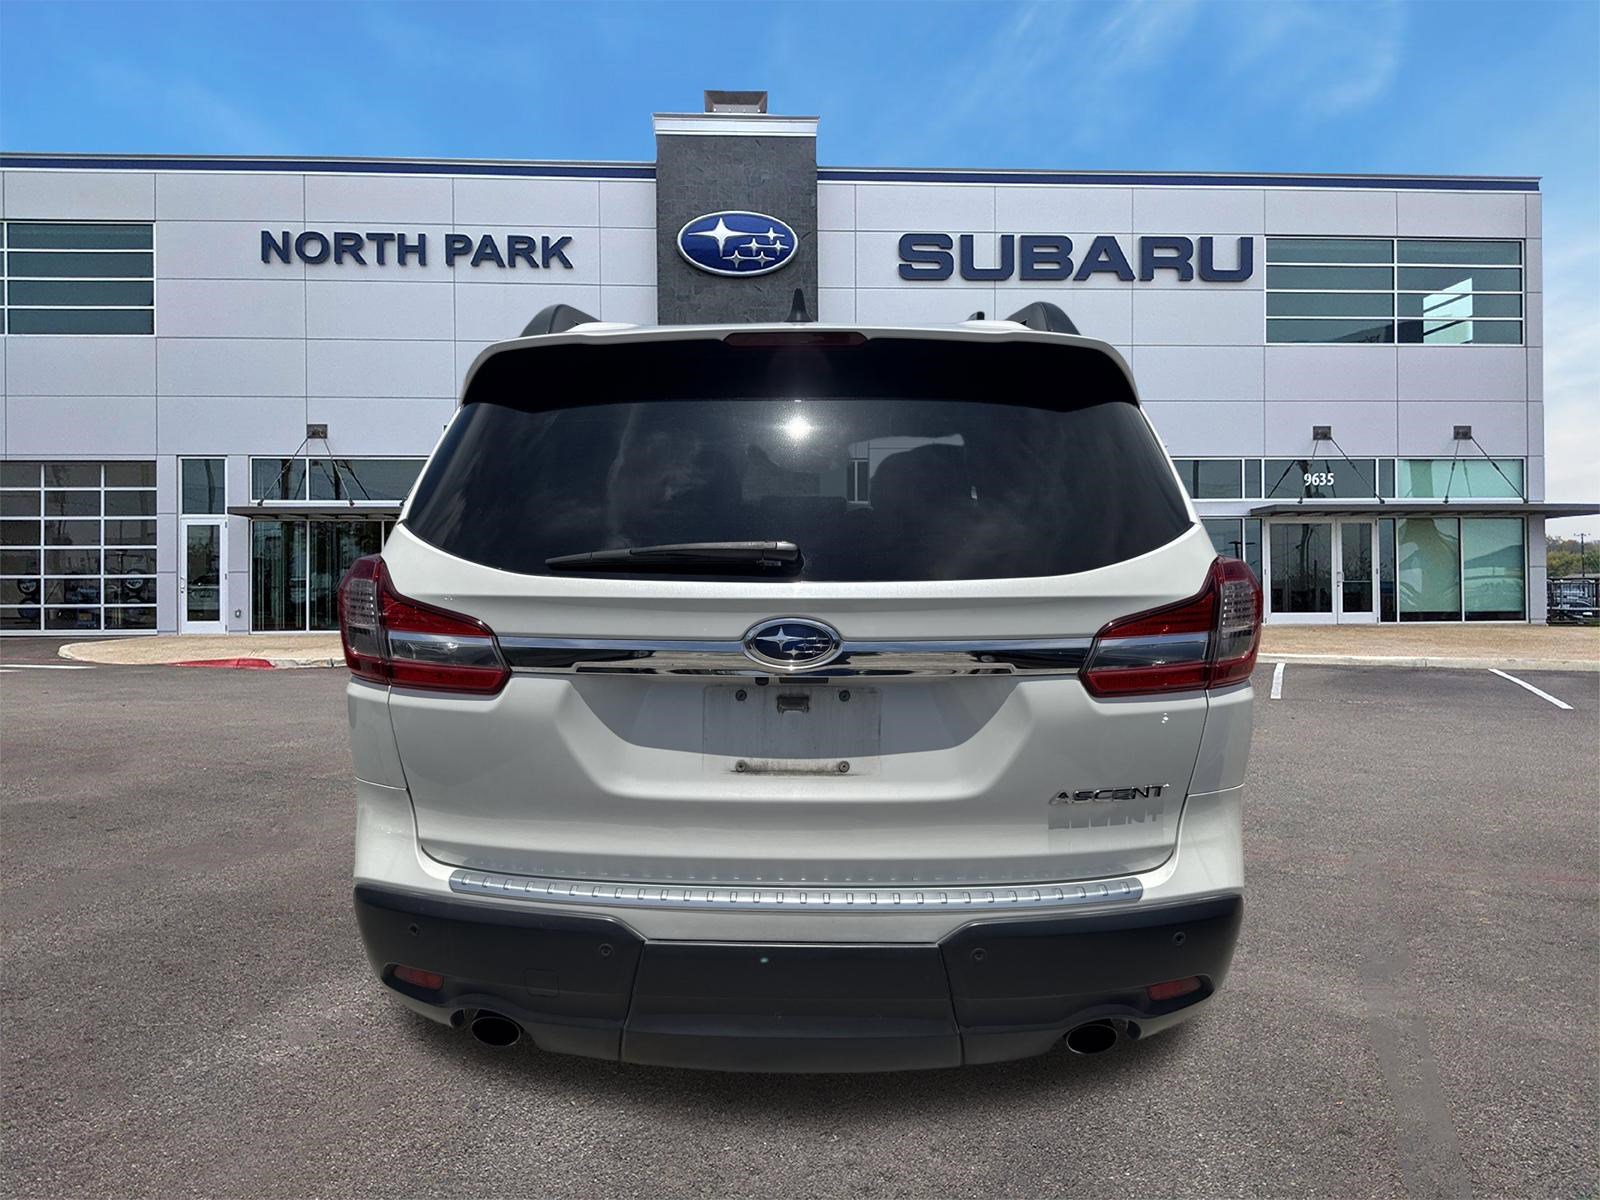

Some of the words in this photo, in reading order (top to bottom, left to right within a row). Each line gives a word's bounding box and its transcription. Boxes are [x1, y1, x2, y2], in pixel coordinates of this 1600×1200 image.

[261, 230, 427, 266] NORTH
[445, 233, 574, 269] PARK
[898, 233, 1254, 282] SUBARU
[1303, 472, 1335, 487] 9635
[1049, 783, 1170, 805] ASCENT
